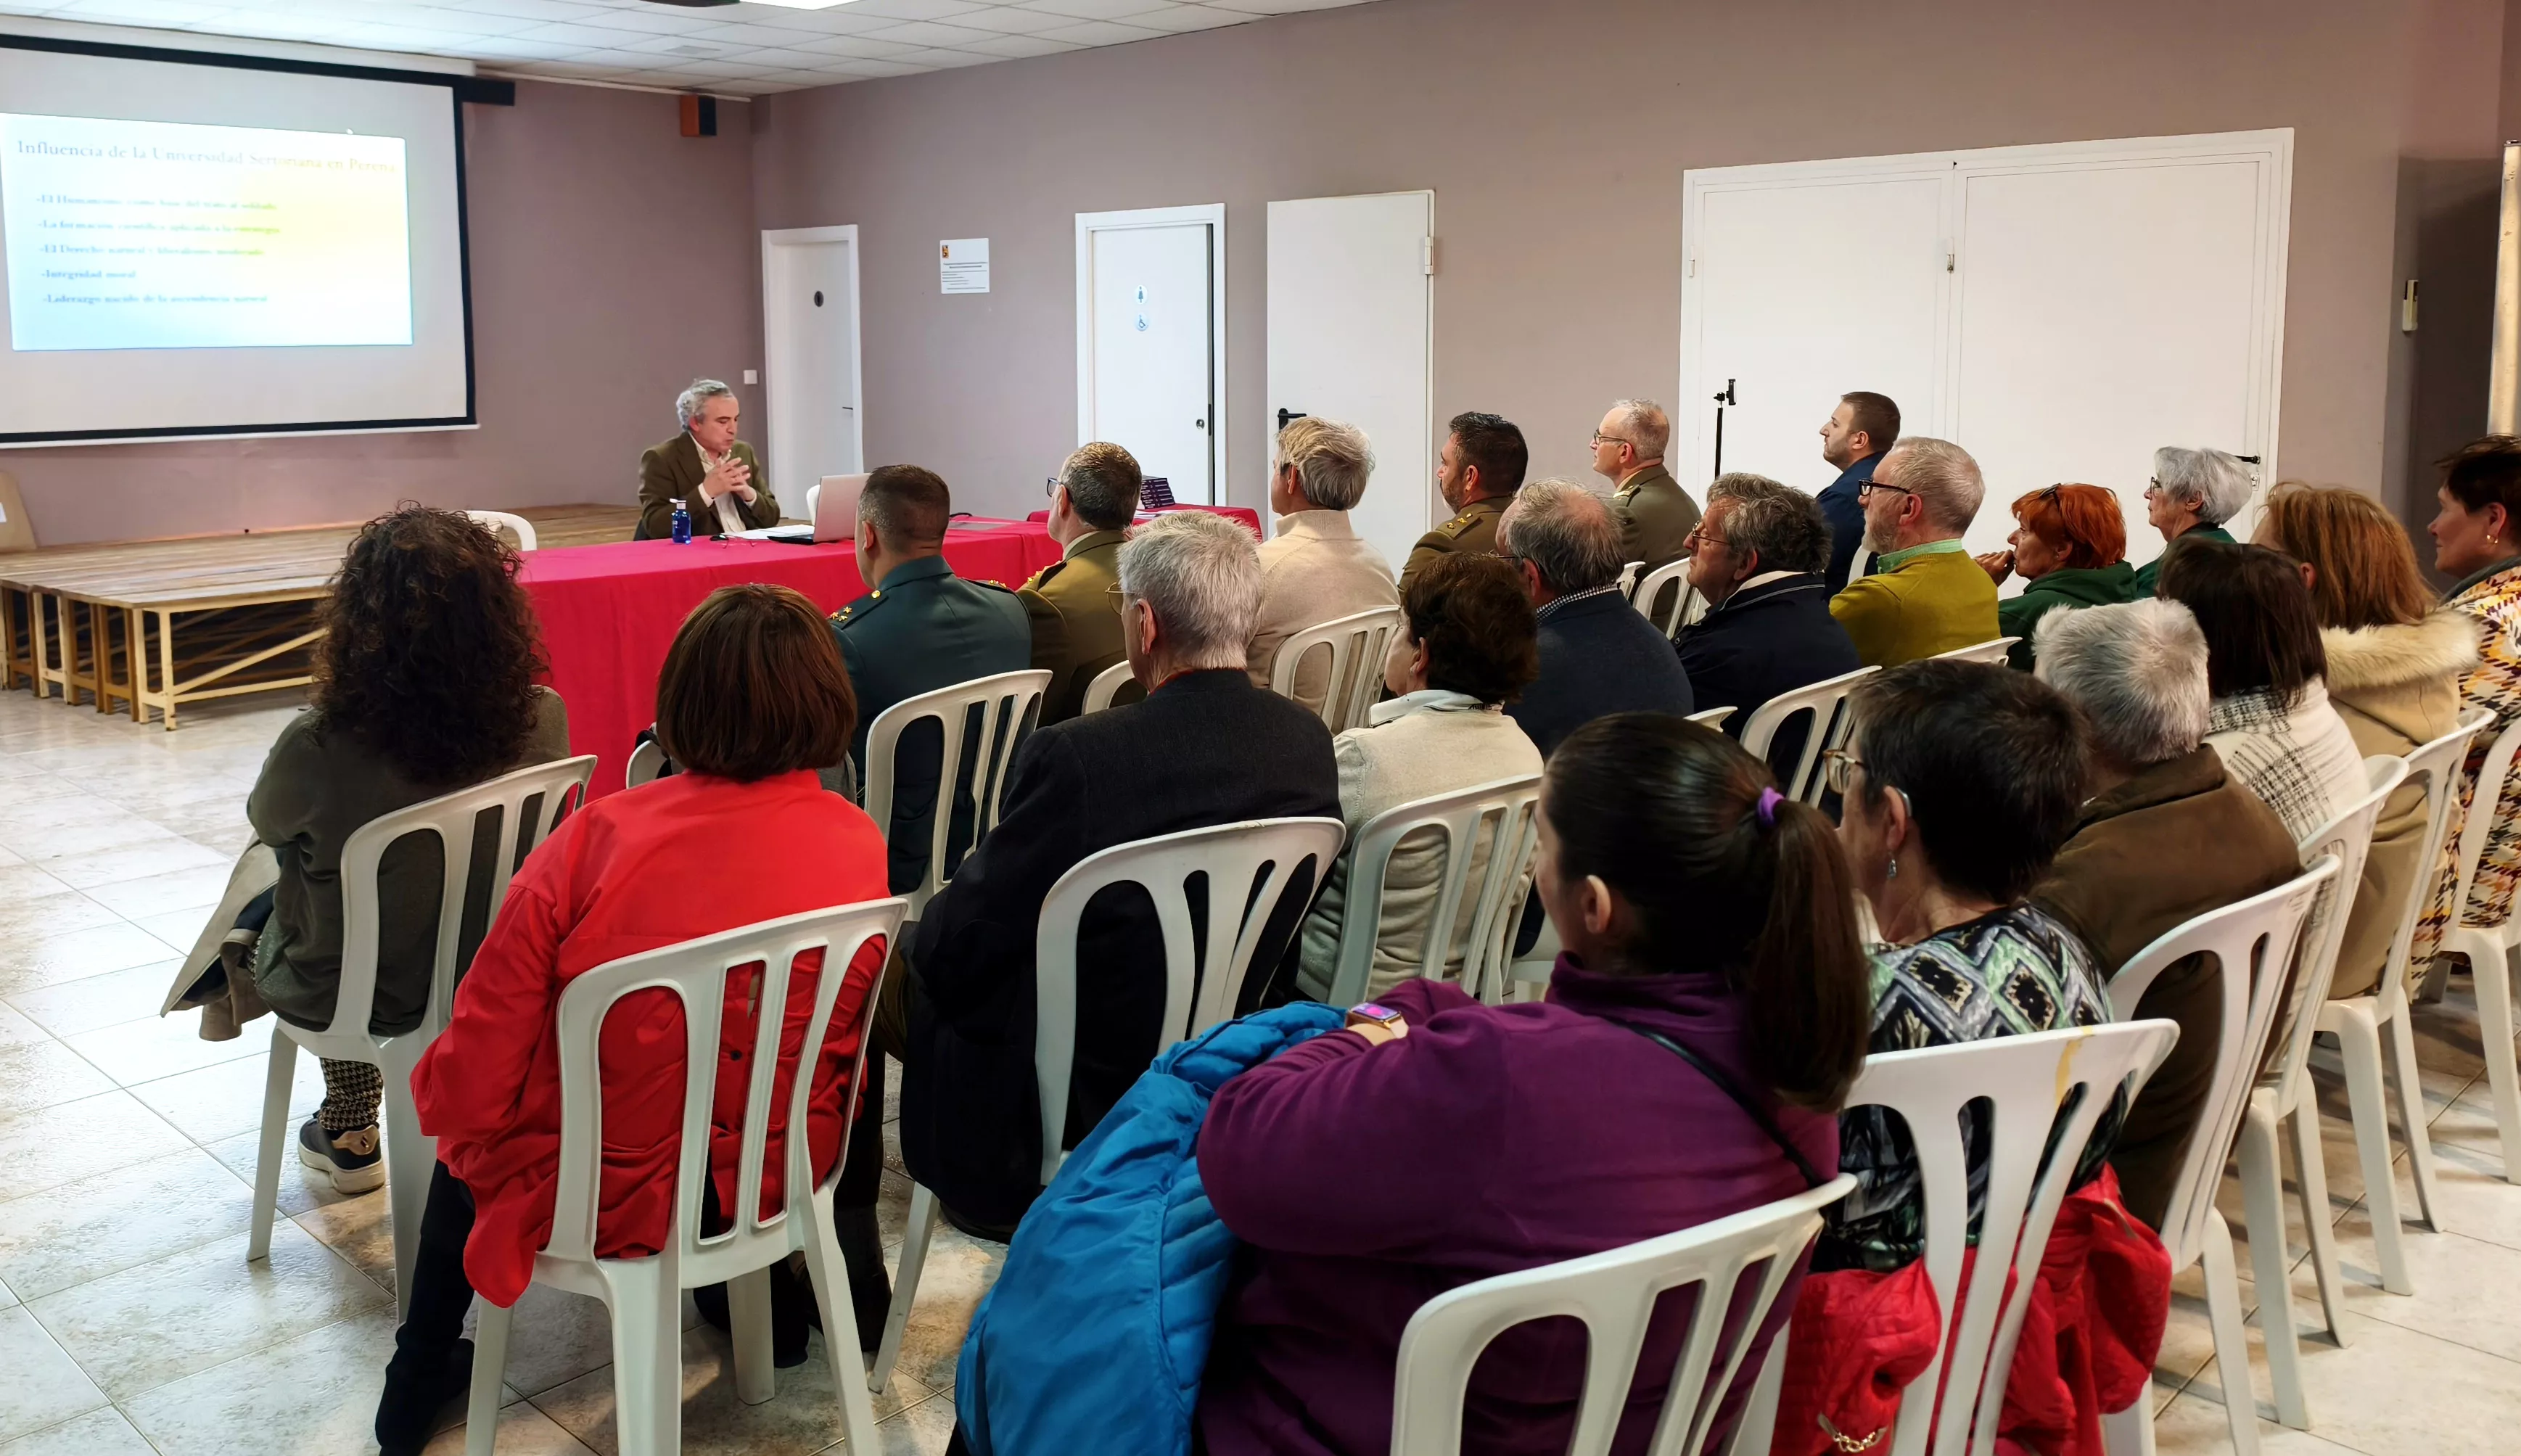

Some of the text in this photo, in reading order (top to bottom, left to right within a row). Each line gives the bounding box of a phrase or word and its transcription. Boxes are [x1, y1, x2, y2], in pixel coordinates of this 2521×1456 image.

[18, 140, 103, 157] Influencia
[108, 146, 128, 159] de
[133, 147, 147, 160] la
[152, 147, 243, 165] Universidad
[327, 160, 343, 171] en
